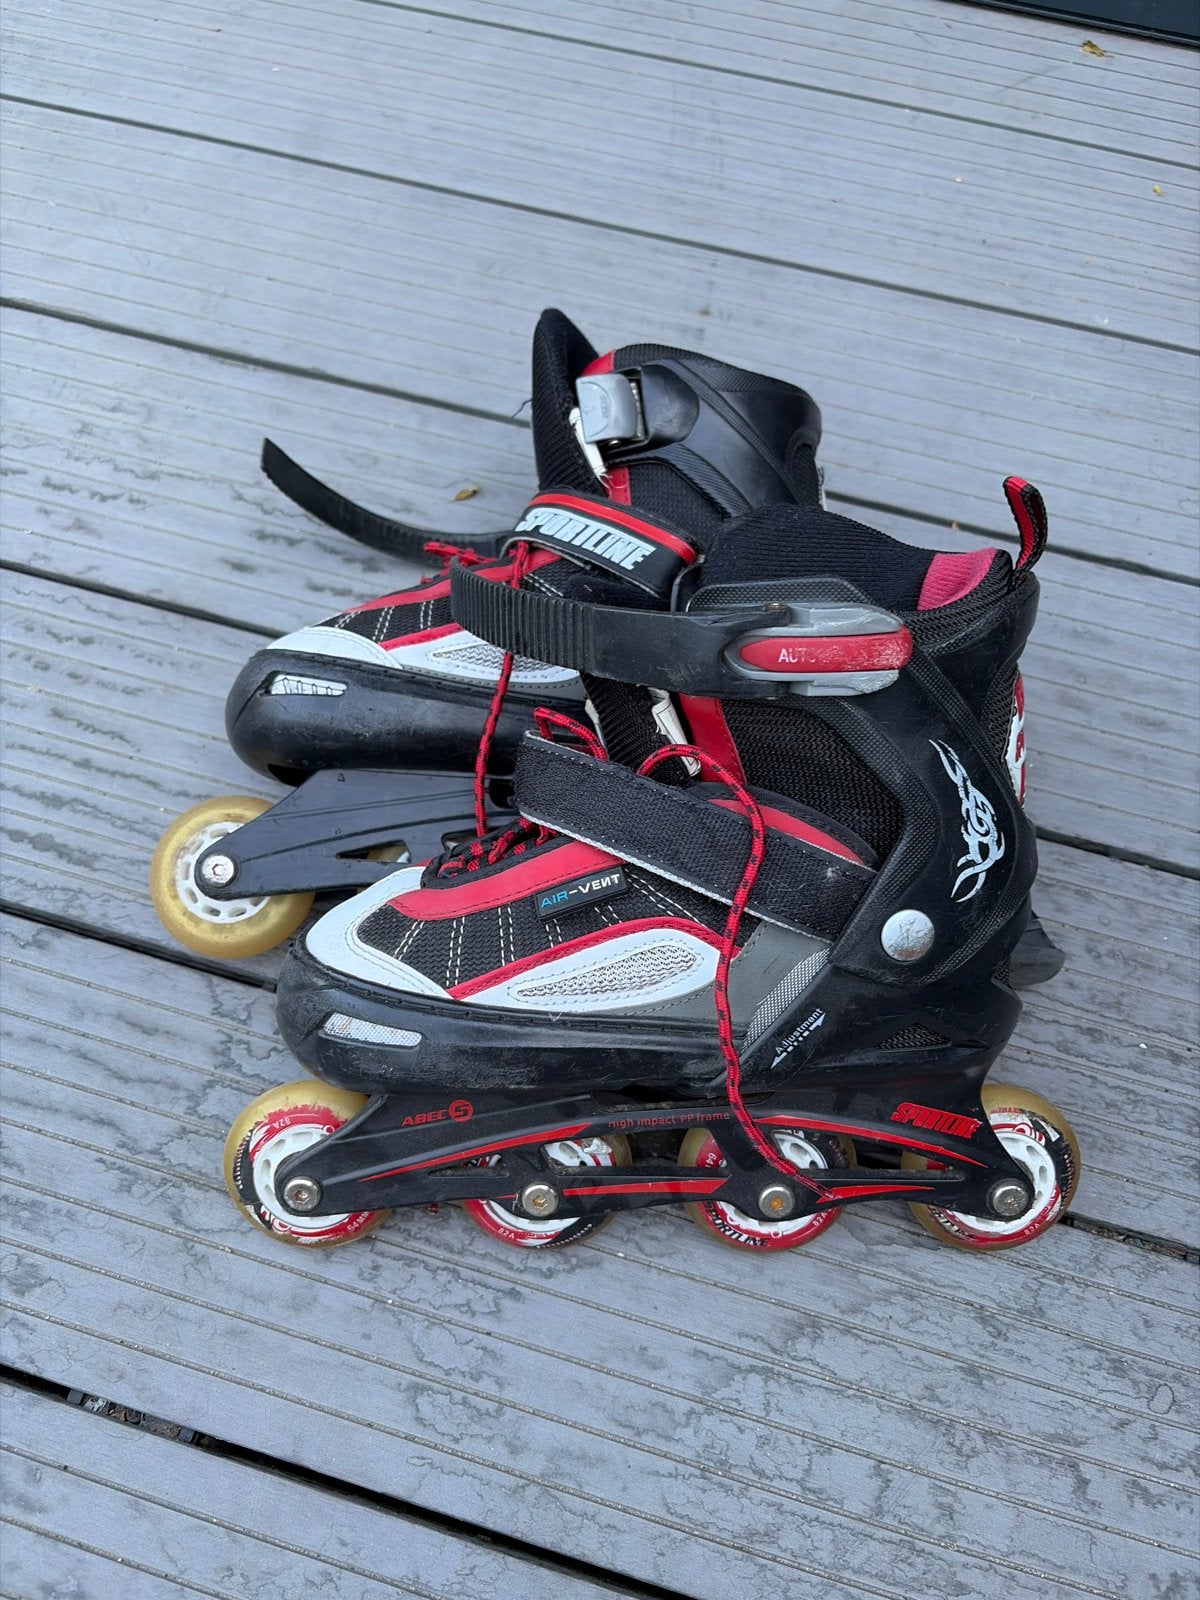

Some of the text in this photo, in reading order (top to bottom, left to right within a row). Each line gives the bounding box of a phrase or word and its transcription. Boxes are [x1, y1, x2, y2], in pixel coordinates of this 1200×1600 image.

[515, 507, 656, 570] SPORTLINE
[541, 874, 620, 907] AIR-VENT
[775, 1008, 824, 1054] Adjustment
[401, 1102, 471, 1127] ABEC 5
[696, 1111, 730, 1122] frame
[890, 1102, 983, 1139] SPORTLINE
